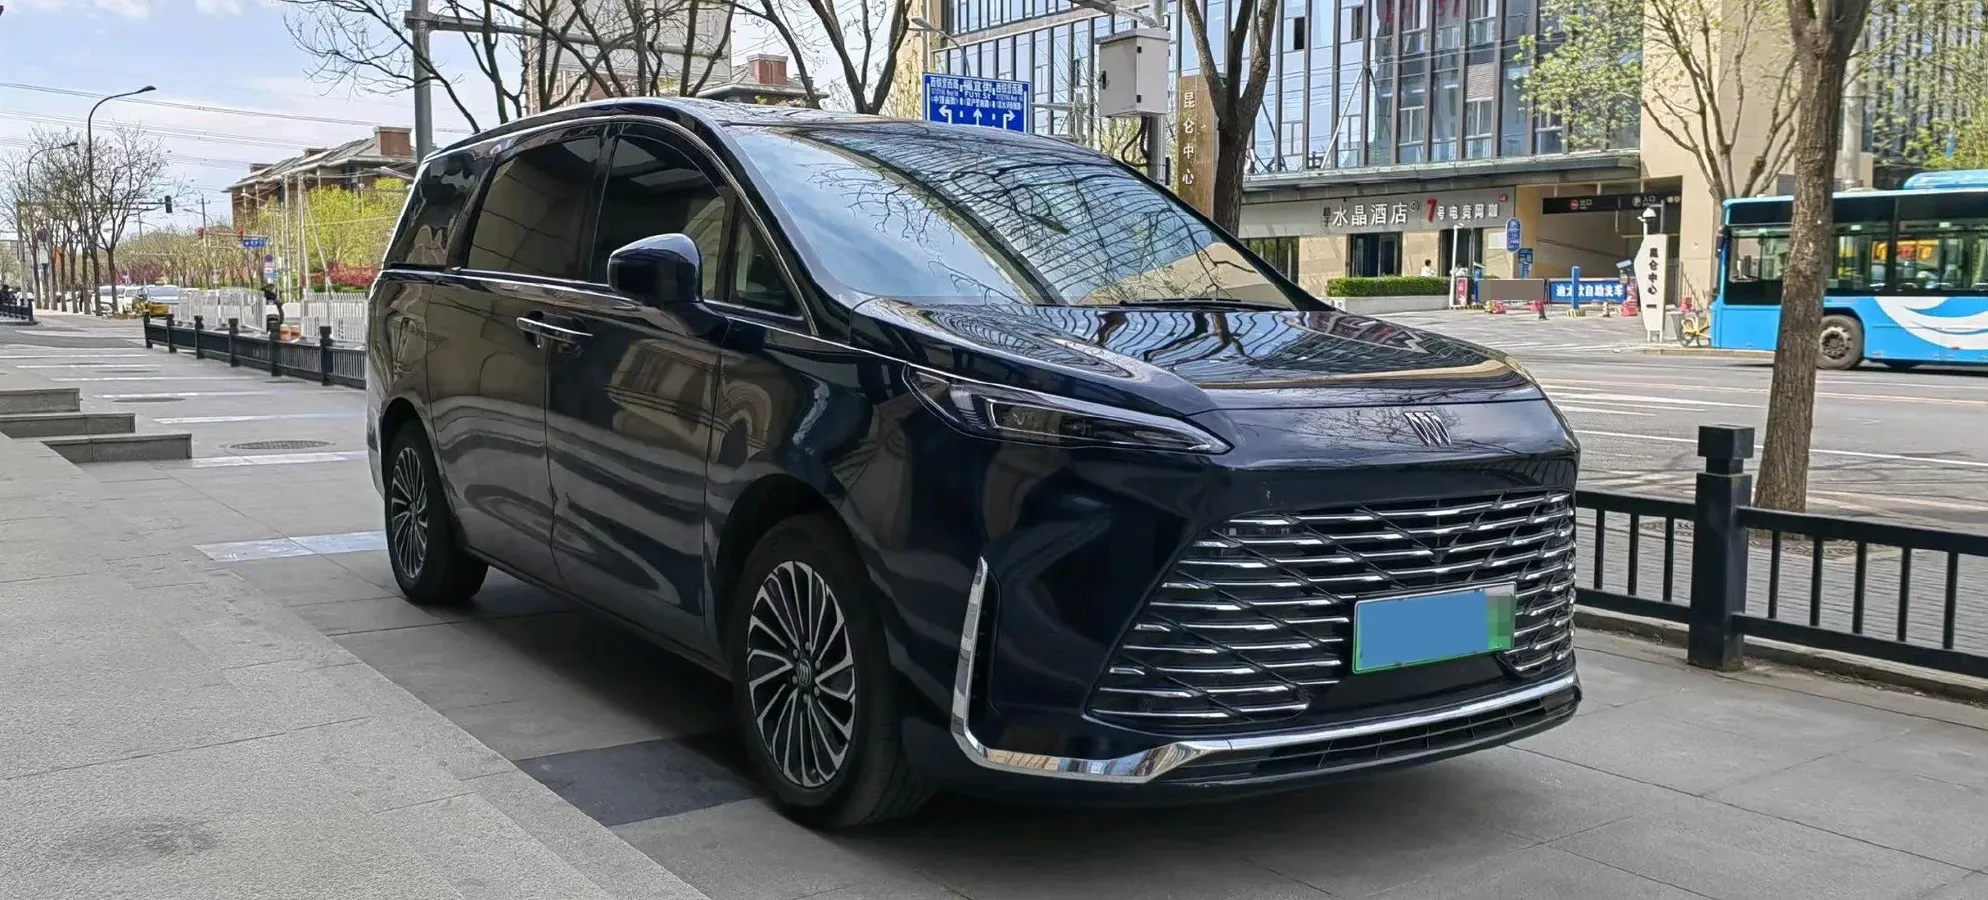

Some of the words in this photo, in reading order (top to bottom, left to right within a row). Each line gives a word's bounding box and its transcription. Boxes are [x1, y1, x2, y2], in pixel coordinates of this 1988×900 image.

[963, 80, 993, 93] 福宜街
[1183, 92, 1195, 185] 昆仑中心
[1332, 202, 1407, 226] 水晶酒店
[1648, 247, 1658, 295] 昆仑中心
